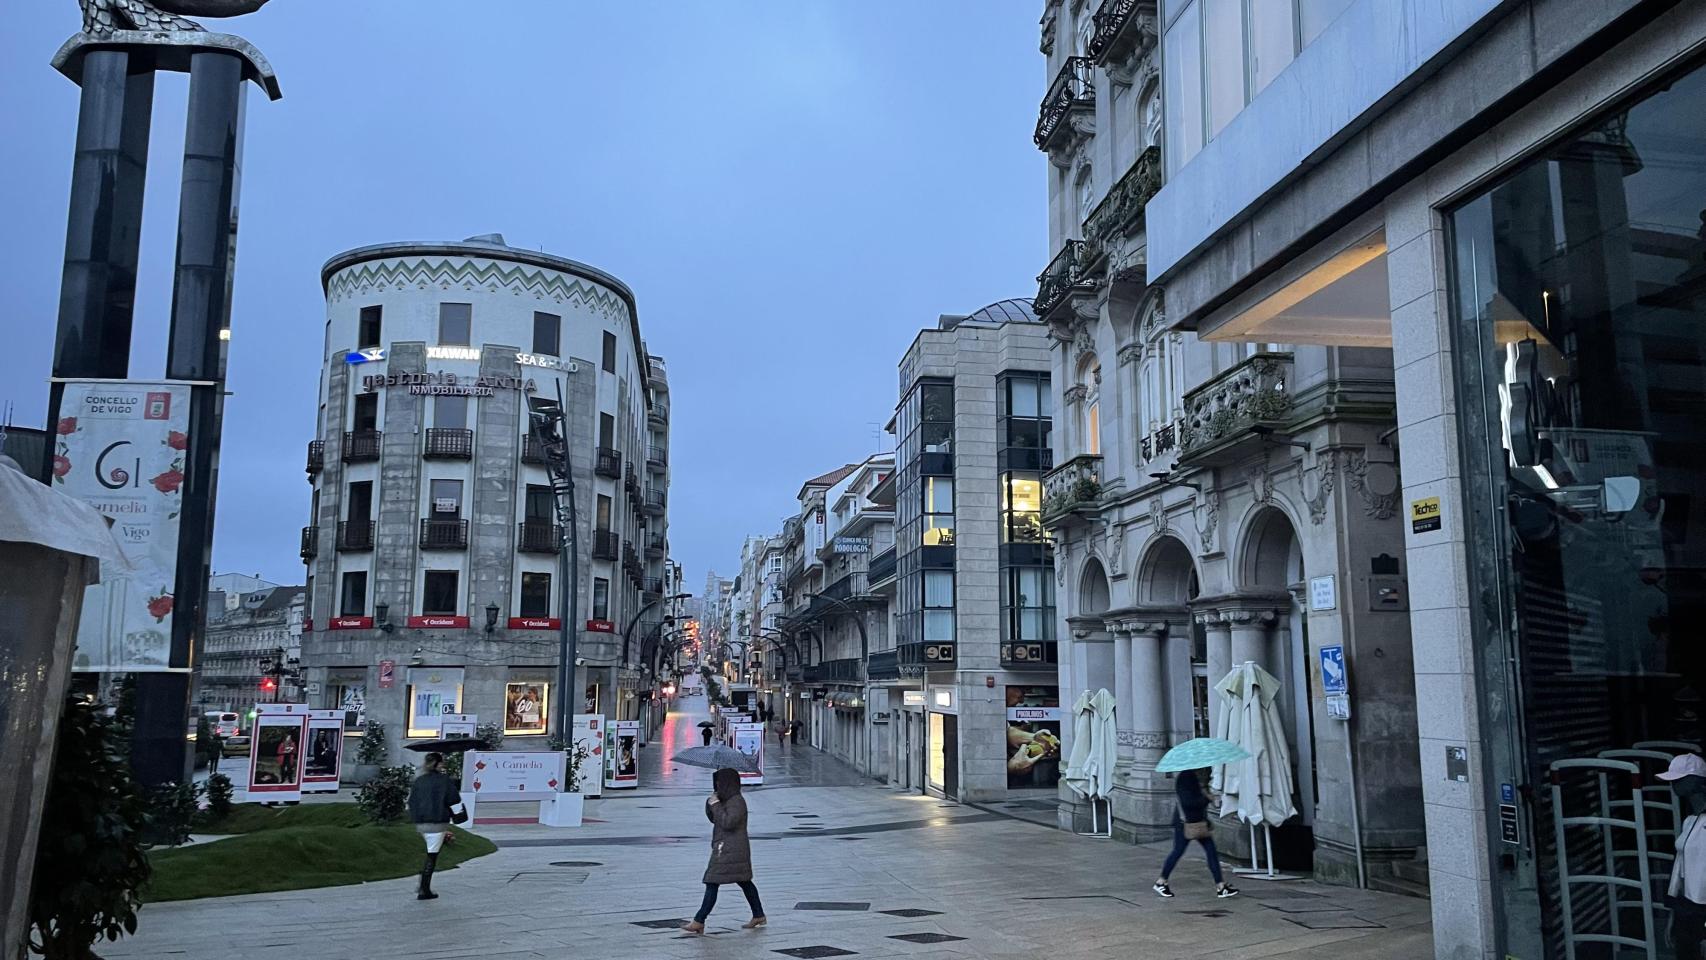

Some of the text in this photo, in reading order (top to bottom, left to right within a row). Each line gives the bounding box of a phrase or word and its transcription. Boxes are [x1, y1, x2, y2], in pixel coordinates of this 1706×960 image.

[514, 353, 536, 366] SEA
[539, 357, 547, 367] &
[408, 385, 494, 396] INMOBILIARIA
[86, 396, 138, 404] CONCELLO
[89, 501, 147, 513] amelia
[122, 526, 150, 540] Vigo
[517, 699, 533, 713] GO
[502, 760, 542, 769] Camelia
